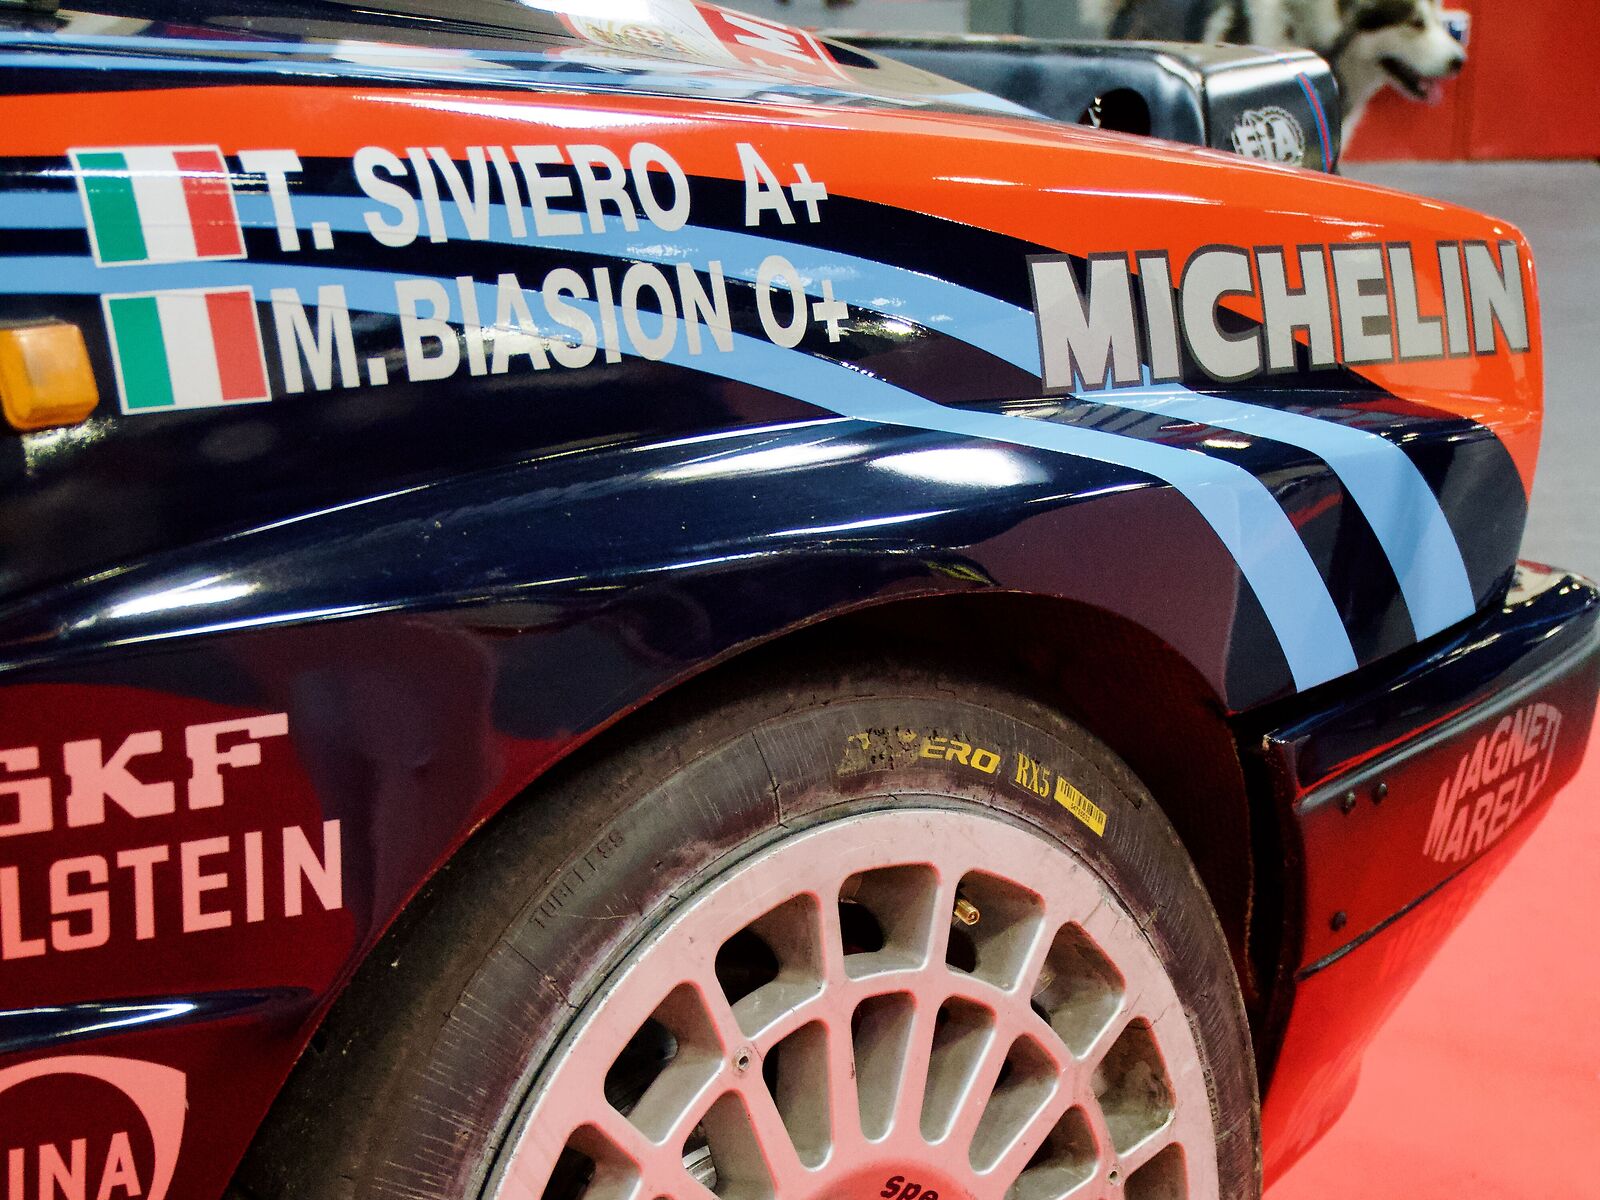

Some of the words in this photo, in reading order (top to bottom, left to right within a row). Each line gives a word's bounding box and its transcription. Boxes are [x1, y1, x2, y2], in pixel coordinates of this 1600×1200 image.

[238, 147, 334, 252] T.
[352, 141, 692, 248] SIVIERO
[735, 142, 829, 227] A+
[1026, 240, 1531, 396] MICHELIN
[1014, 752, 1051, 799] RX5
[0, 818, 343, 961] LSTEIN
